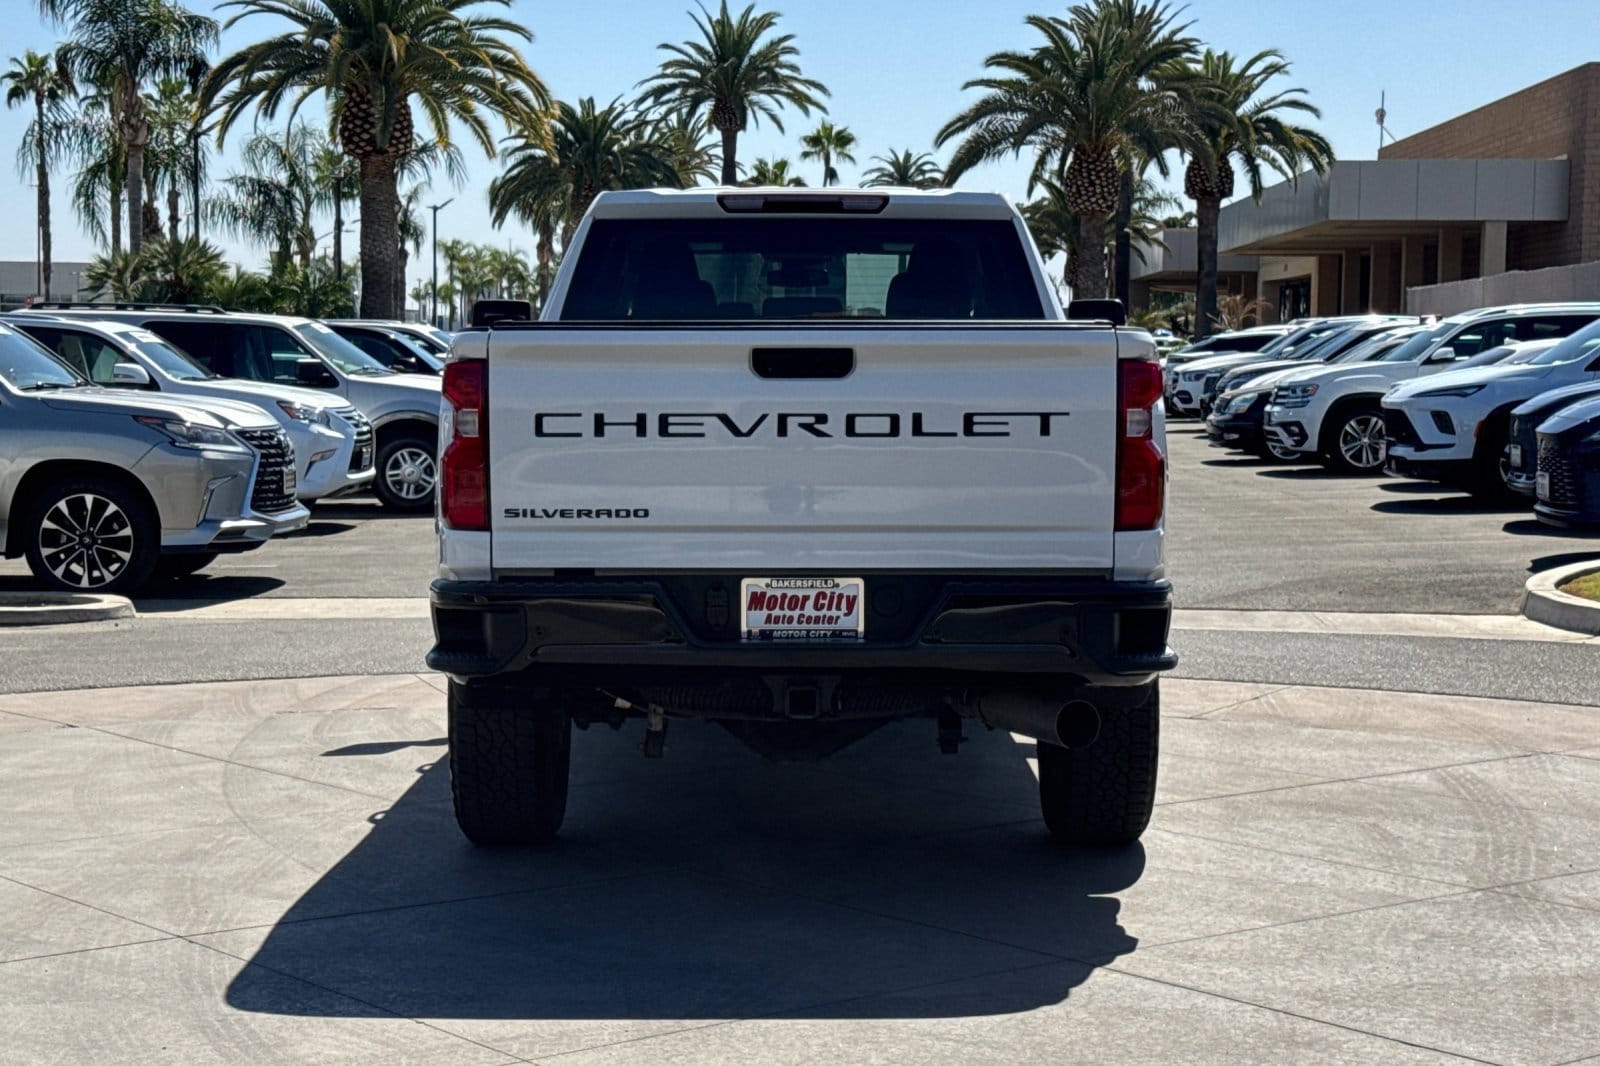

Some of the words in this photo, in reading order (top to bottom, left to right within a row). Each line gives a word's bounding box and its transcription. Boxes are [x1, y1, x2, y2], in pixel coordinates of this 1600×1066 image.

[535, 412, 1070, 437] CHEVROLET
[504, 508, 650, 519] SILVERADO
[771, 580, 834, 588] BAKERSFIELD
[748, 591, 810, 611] Motor
[813, 591, 857, 617] City
[764, 613, 794, 625] Auto
[797, 613, 840, 625] Center
[773, 630, 806, 638] MOTOR
[810, 630, 832, 638] CITY
